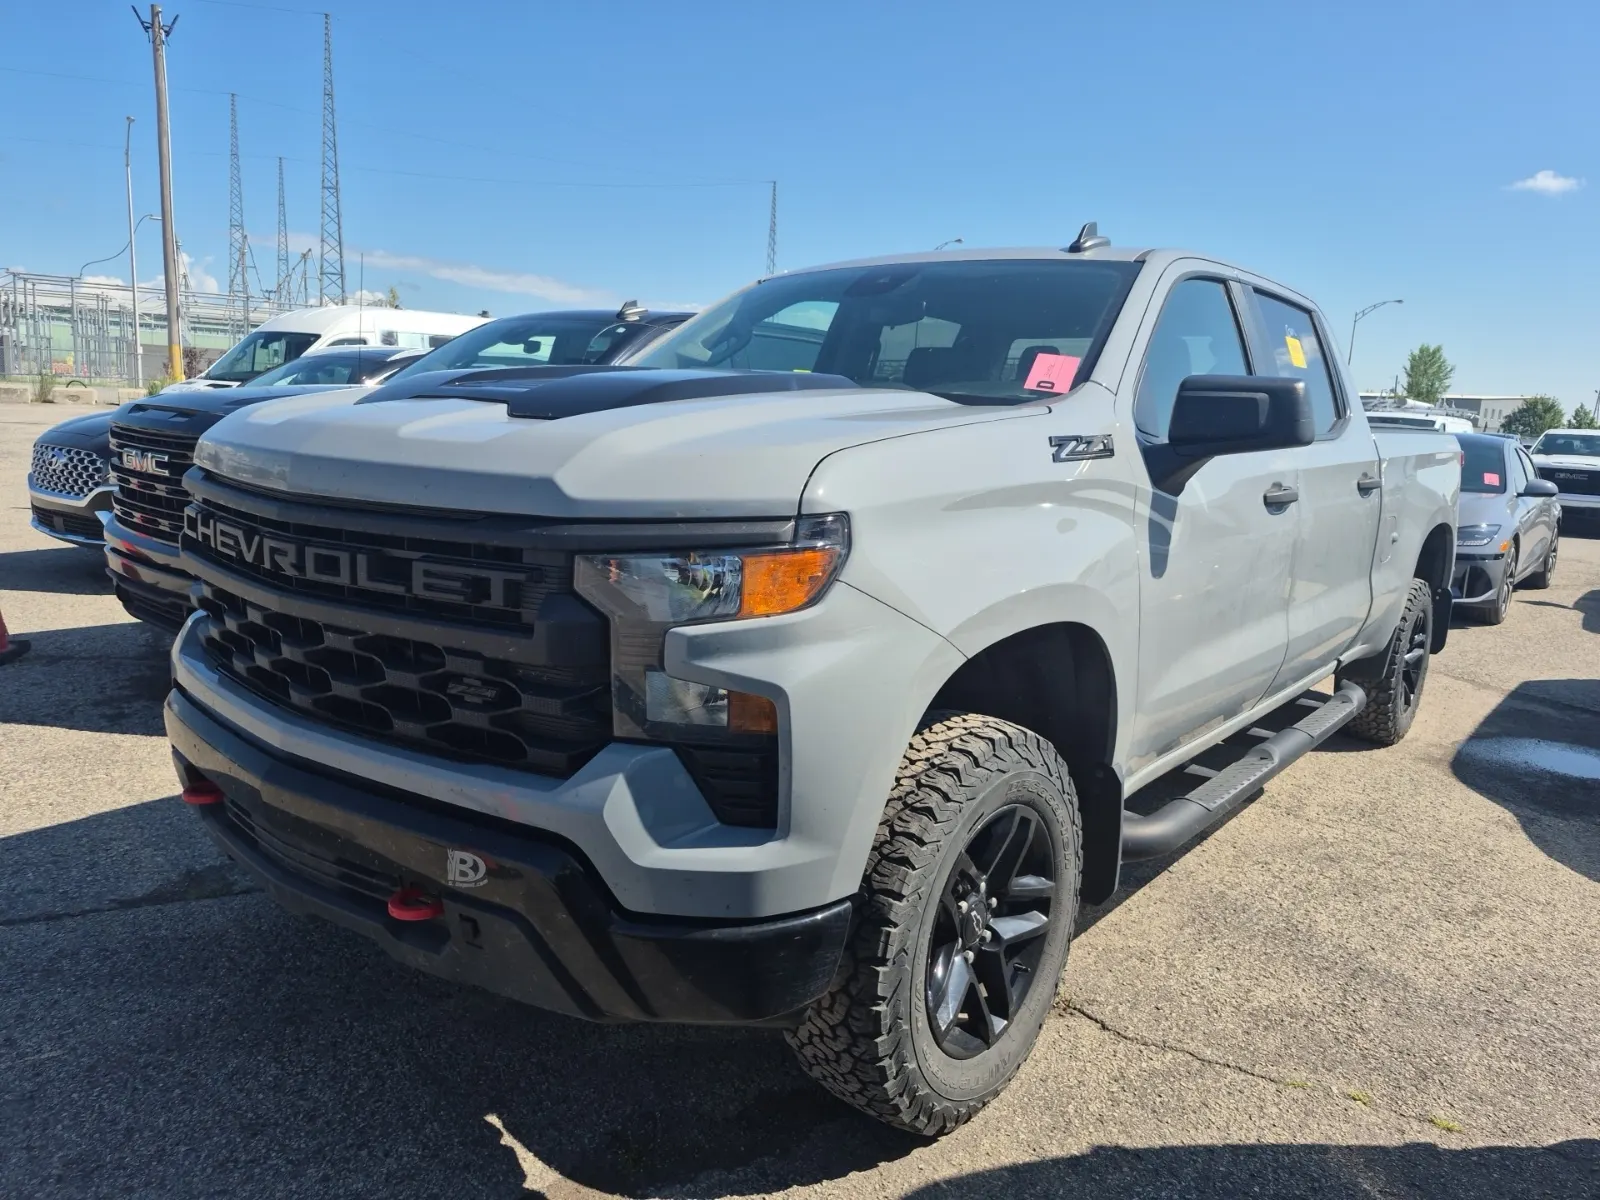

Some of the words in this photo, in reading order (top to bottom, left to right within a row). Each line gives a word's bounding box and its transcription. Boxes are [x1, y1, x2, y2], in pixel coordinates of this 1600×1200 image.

[123, 447, 170, 477] GMC
[1554, 472, 1589, 480] GMC
[184, 506, 528, 604] CHEVROLET
